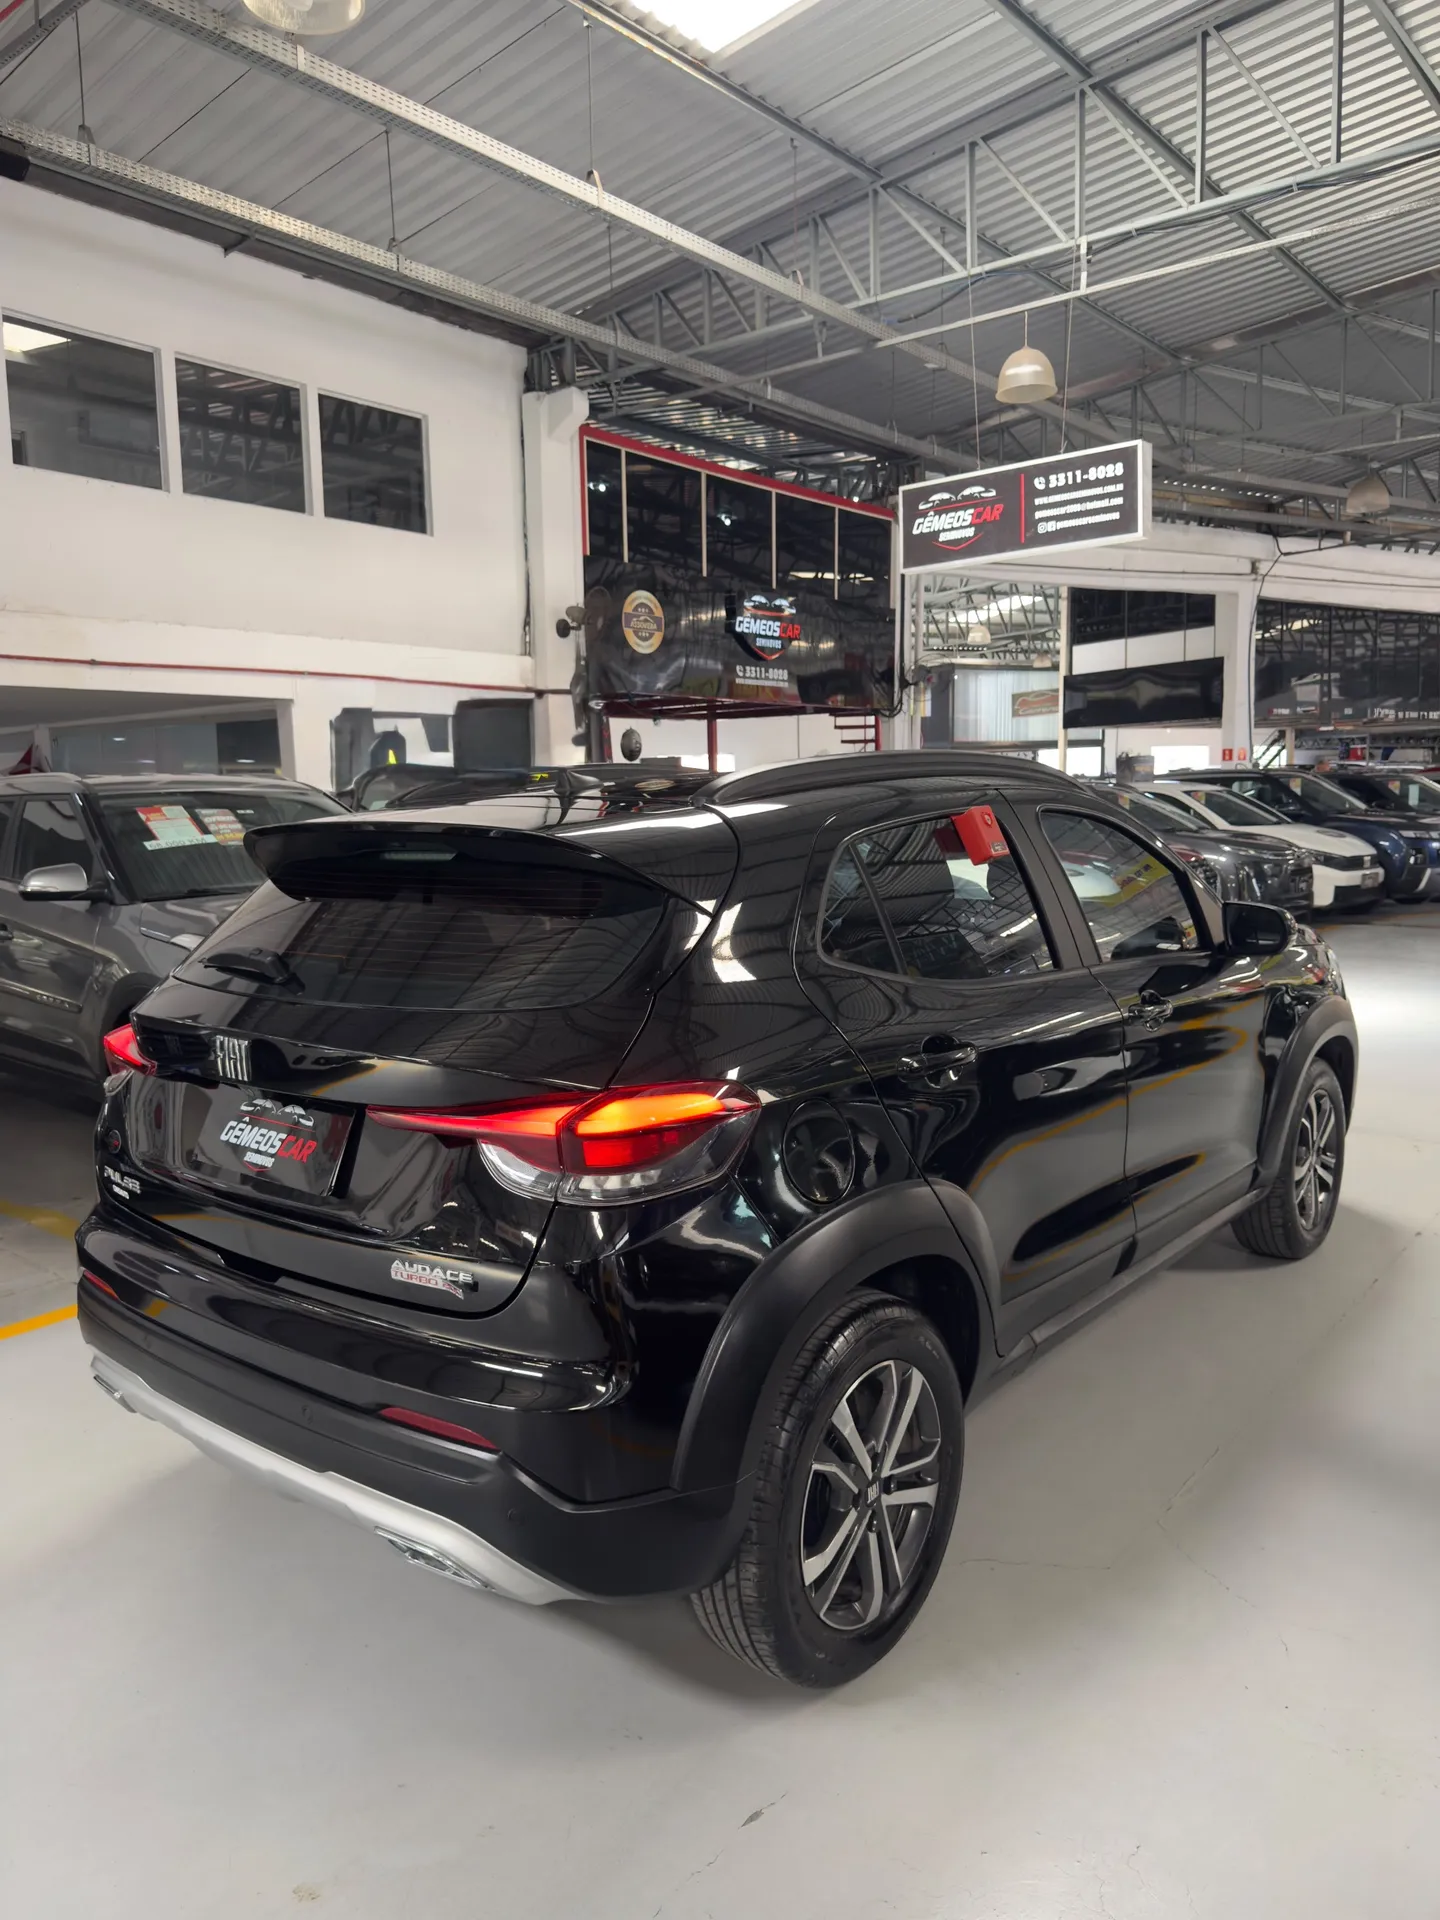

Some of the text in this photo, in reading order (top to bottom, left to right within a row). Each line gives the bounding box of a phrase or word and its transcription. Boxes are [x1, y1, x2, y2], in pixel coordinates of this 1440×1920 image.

[1048, 462, 1124, 488] 3311-8028
[745, 666, 788, 680] 3311-8028
[214, 1035, 250, 1082] FIAT
[391, 1258, 474, 1284] AUDACE
[391, 1270, 438, 1287] TURBO
